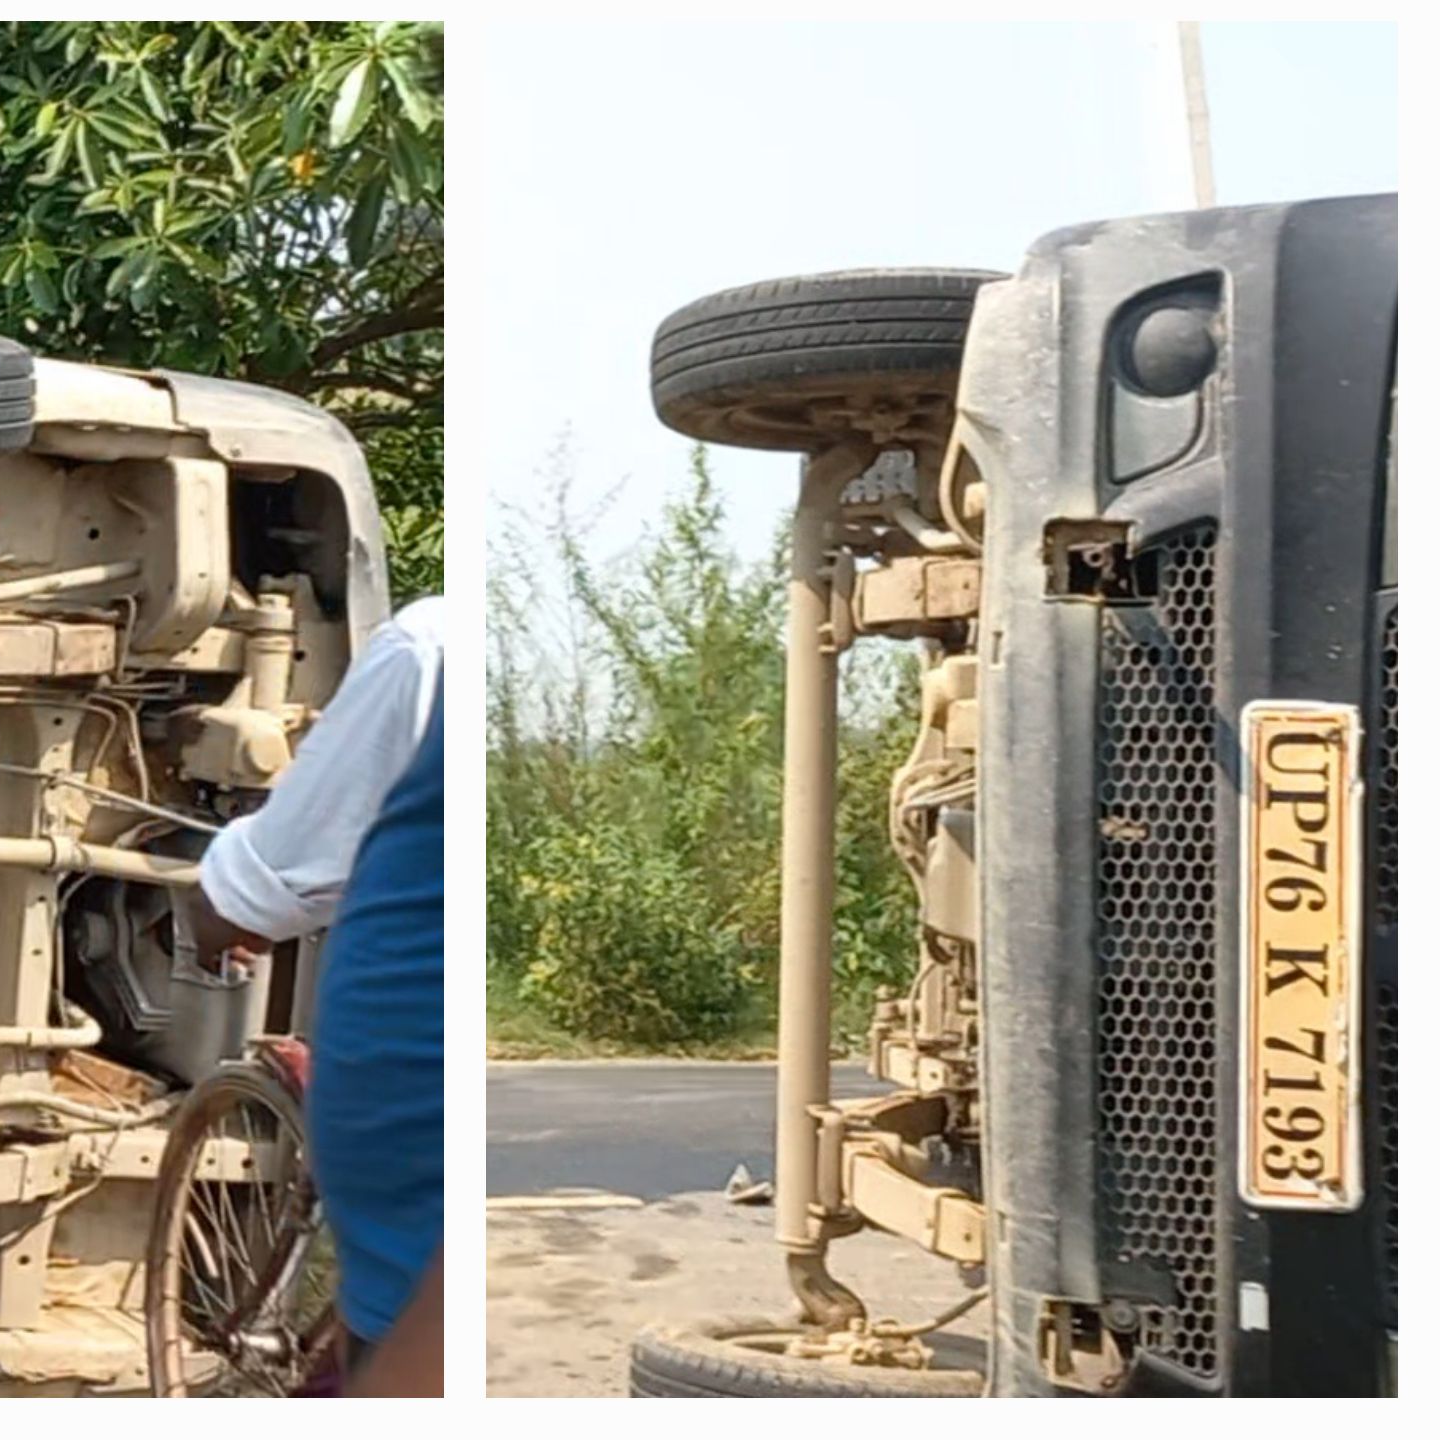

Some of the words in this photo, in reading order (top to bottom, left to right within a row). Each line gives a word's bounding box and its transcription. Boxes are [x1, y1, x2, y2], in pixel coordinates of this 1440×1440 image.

[1265, 731, 1331, 913] UP76
[1264, 941, 1329, 998] K
[1262, 1027, 1326, 1183] 7193
